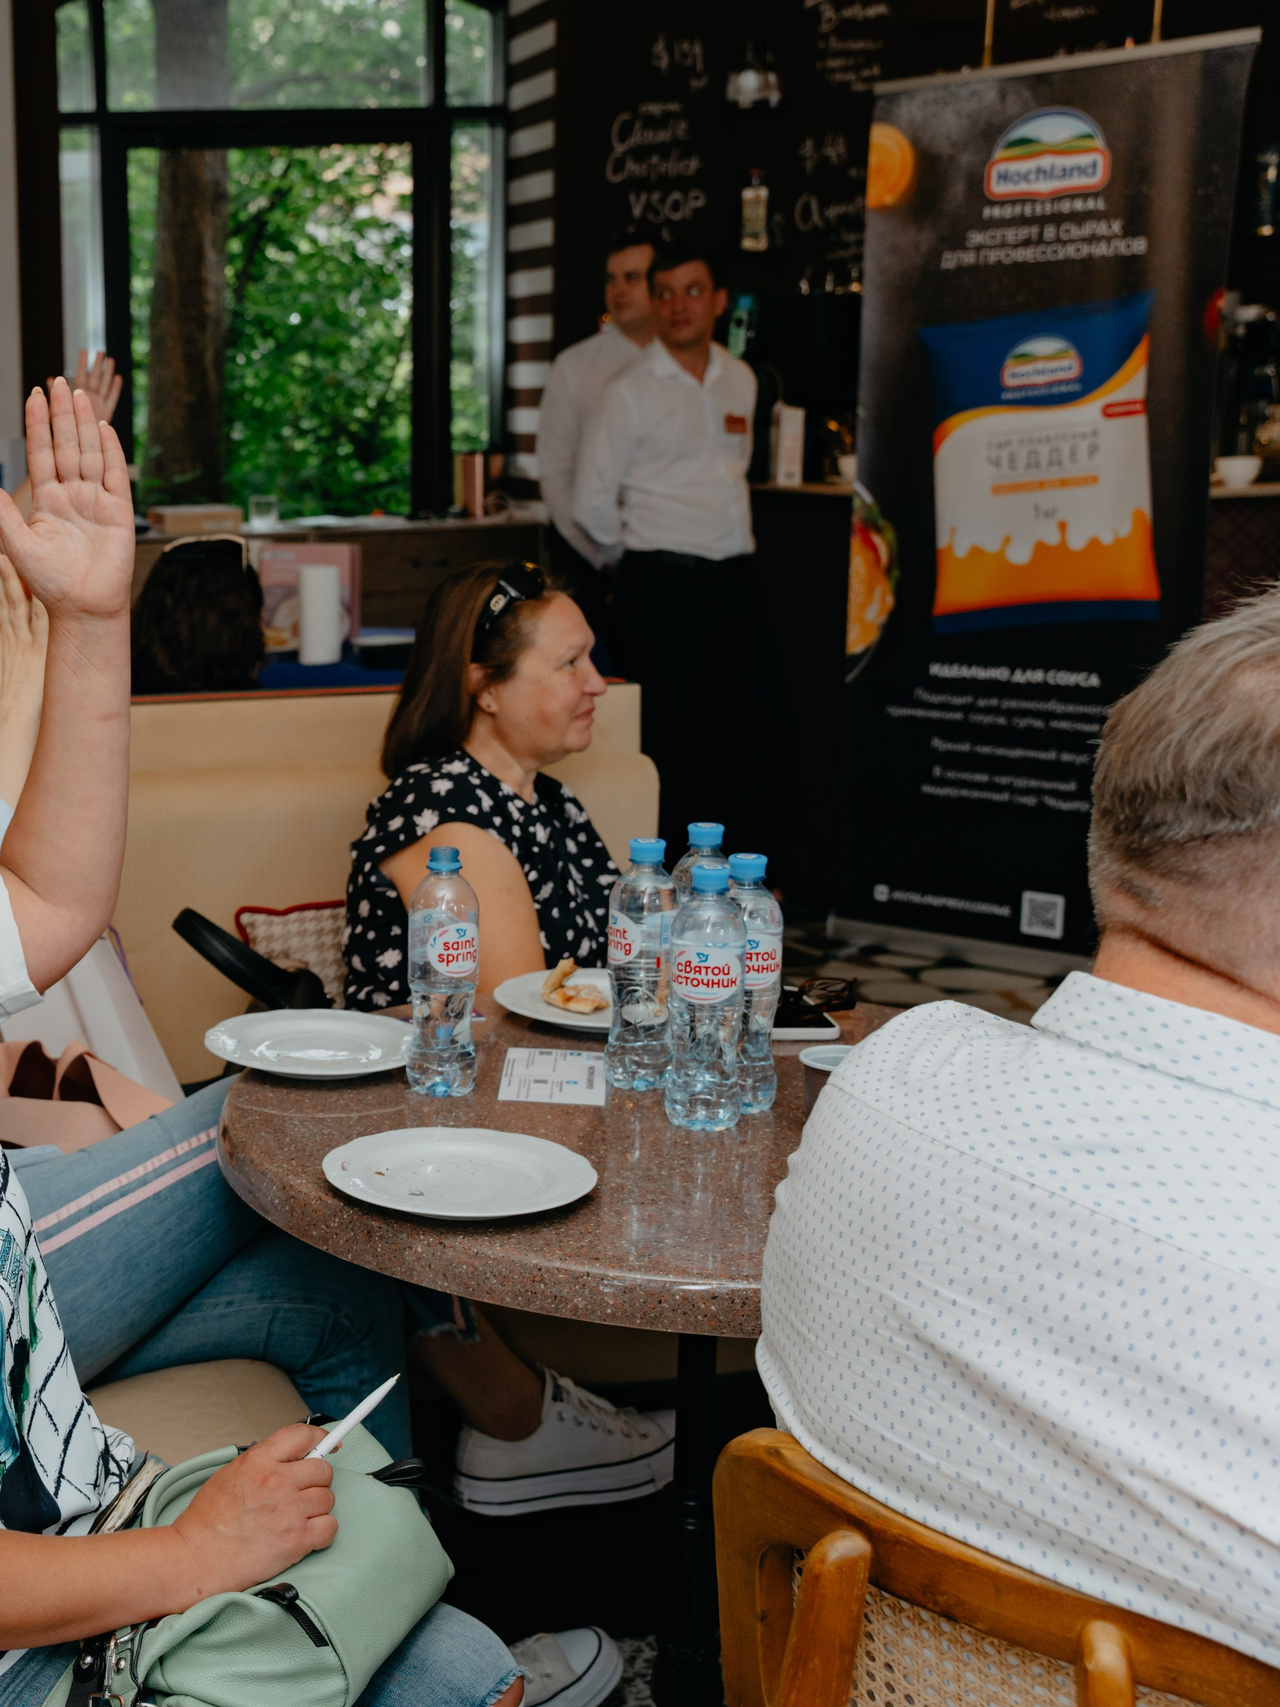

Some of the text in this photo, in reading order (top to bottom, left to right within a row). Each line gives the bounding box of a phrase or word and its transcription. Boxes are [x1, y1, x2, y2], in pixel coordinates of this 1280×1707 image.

[996, 158, 1098, 187] Hochland
[628, 188, 707, 223] VSOP
[983, 195, 1106, 219] PROFESSIONAL
[966, 217, 1124, 248] ЭКСПЕРТ В СЫРАХ
[940, 235, 1148, 270] ДЛЯ ПРОФЕССИОНАЛОВ
[985, 443, 1099, 472] ЧЕДДЕР
[928, 662, 1102, 688] ИДЕАЛЬНО ДЛЯ СОУСА
[443, 936, 475, 951] saint
[608, 926, 628, 940] aint
[438, 949, 477, 967] spring
[608, 938, 632, 956] ring
[745, 948, 777, 962] ятой
